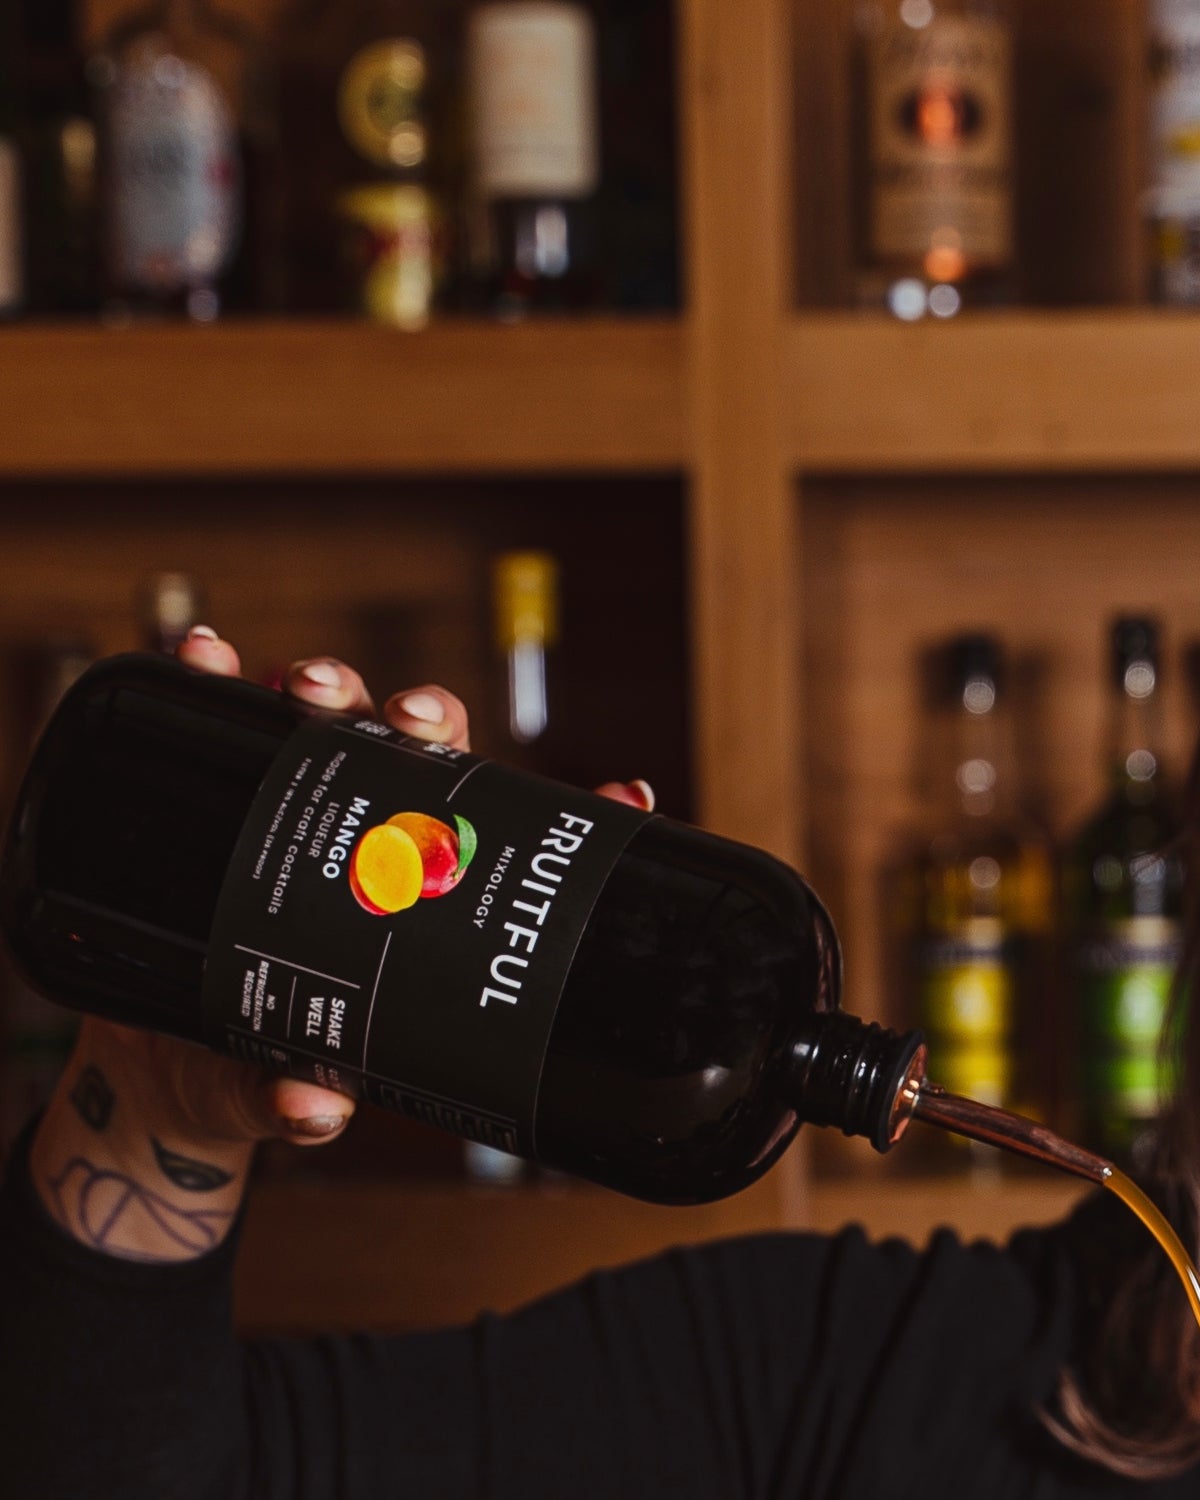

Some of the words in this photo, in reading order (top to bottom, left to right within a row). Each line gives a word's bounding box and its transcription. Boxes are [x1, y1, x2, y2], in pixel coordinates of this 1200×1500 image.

[321, 751, 347, 782] made
[311, 784, 328, 803] for
[293, 806, 315, 841] craft
[308, 801, 340, 858] LIQUEUR
[322, 796, 371, 879] MANGO
[268, 845, 299, 915] cocktails
[472, 845, 516, 929] MIXOLOGY
[479, 812, 594, 1008] FRUITFUL
[241, 970, 256, 1017] REQUIRED
[266, 994, 276, 1011] NO
[306, 997, 325, 1037] WELL
[326, 997, 346, 1049] SHAKE
